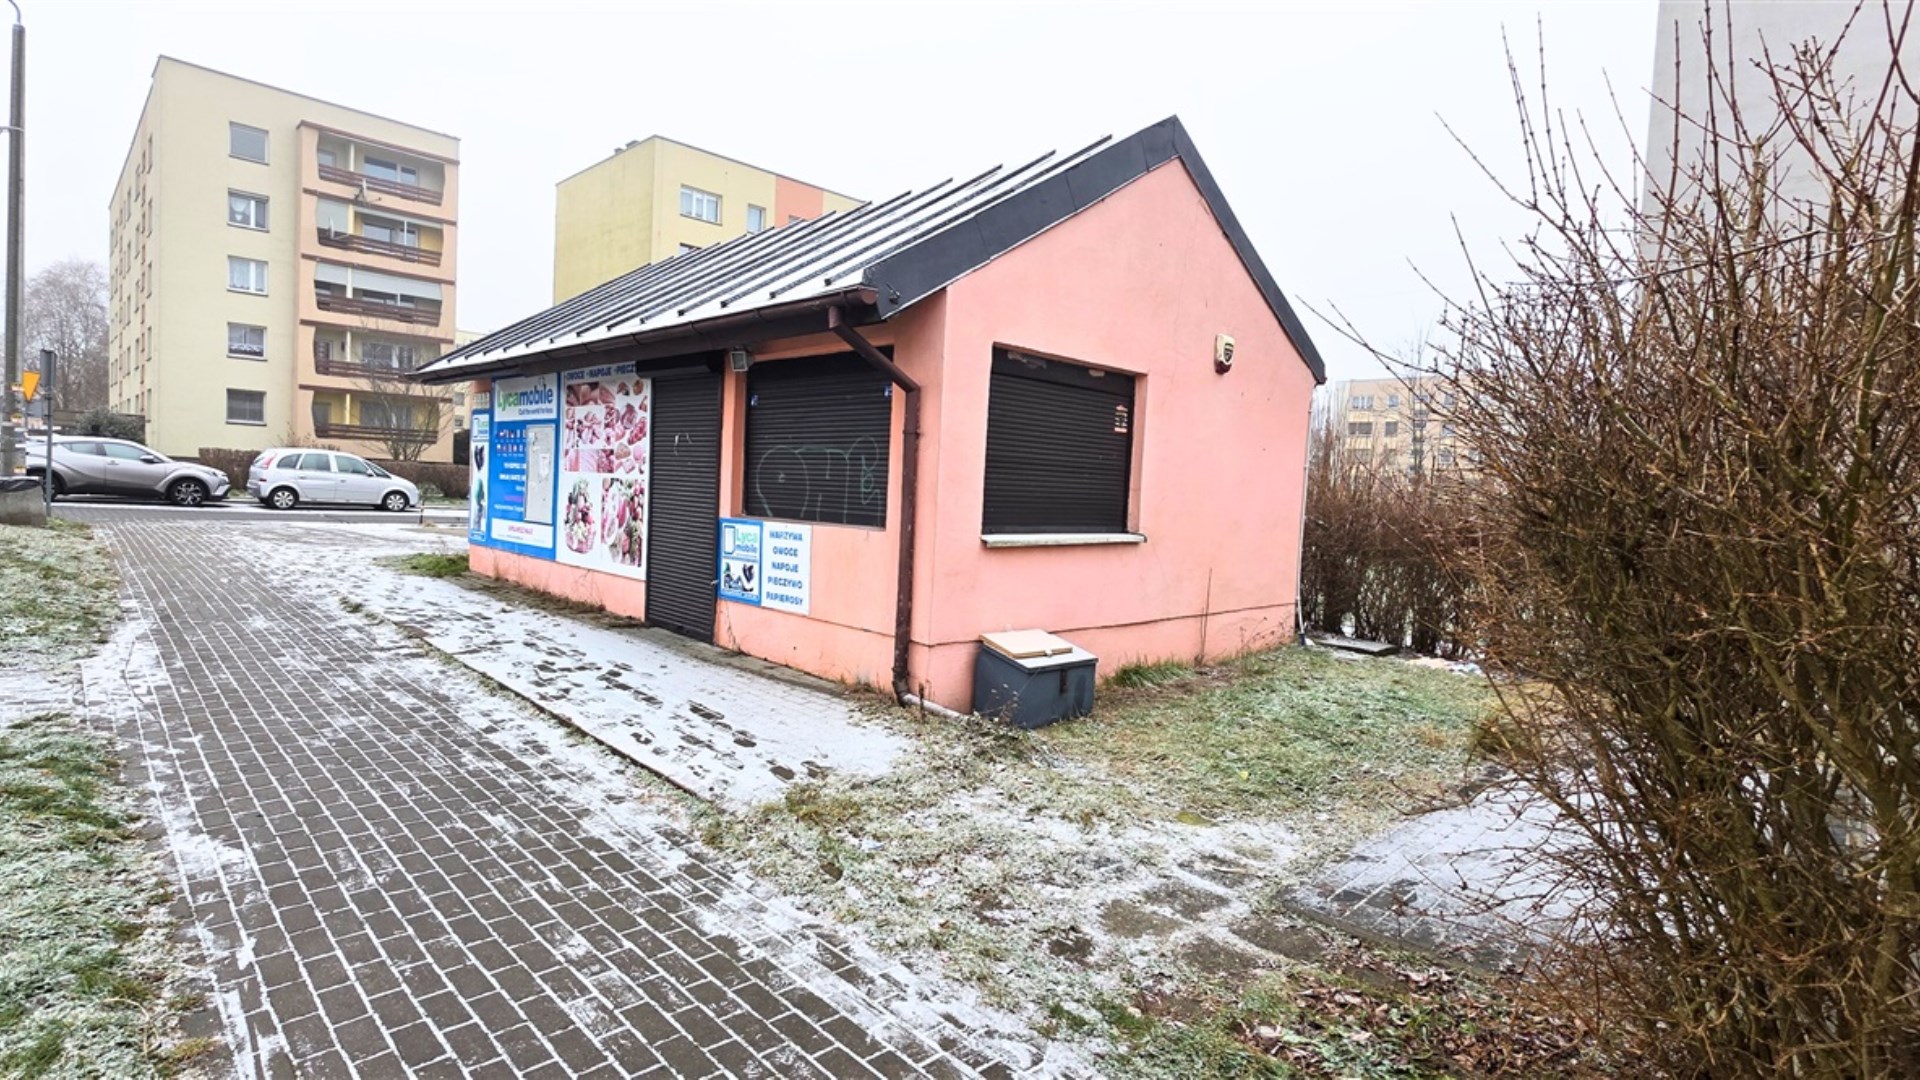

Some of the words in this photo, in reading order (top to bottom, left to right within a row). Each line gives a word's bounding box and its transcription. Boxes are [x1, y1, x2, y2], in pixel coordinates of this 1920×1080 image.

[497, 384, 553, 412] Lycamobile
[736, 528, 758, 544] Lyca
[735, 543, 758, 554] mobile
[772, 545, 799, 558] OWOCE
[771, 561, 800, 573] NAPOJE
[767, 575, 803, 590] PIECZYWO
[765, 590, 803, 607] PAPIEROSY
